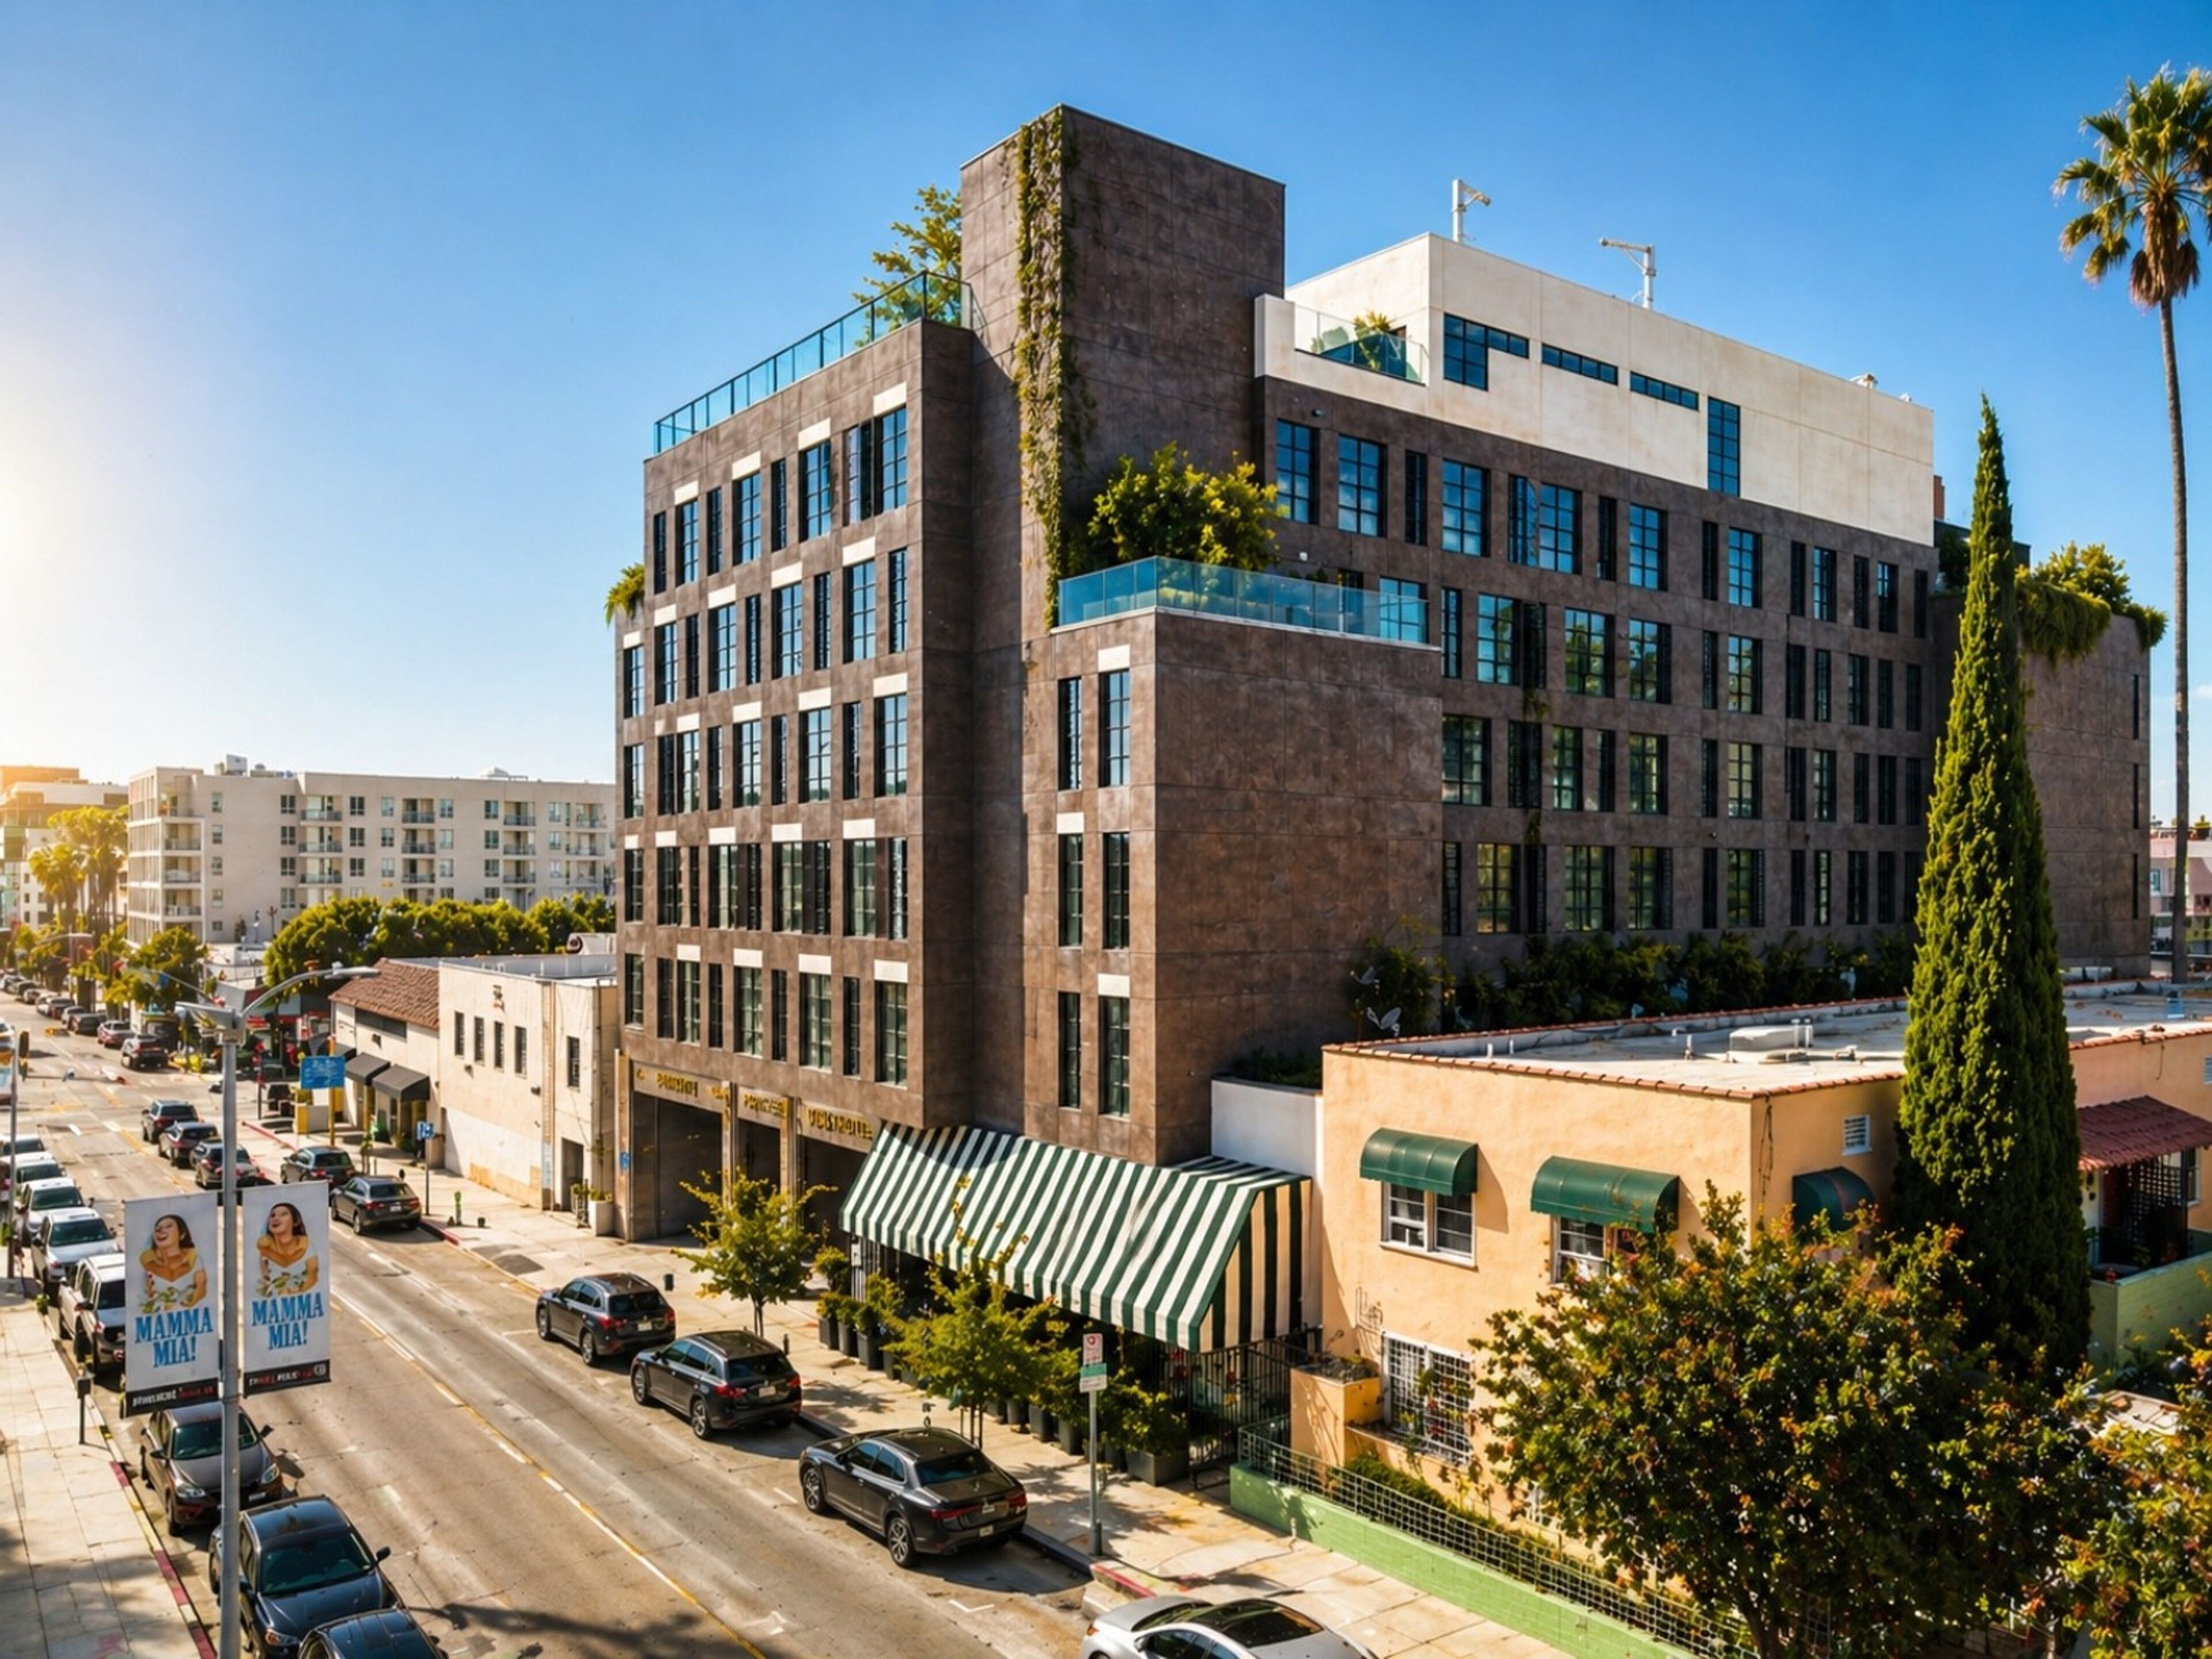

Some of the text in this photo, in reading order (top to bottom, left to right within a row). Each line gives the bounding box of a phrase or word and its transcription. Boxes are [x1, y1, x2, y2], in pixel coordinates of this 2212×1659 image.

[135, 1307, 214, 1343] MAMMA
[252, 1292, 324, 1326] MAMMA
[153, 1336, 196, 1368] MIA!
[268, 1321, 308, 1350] MIA!
